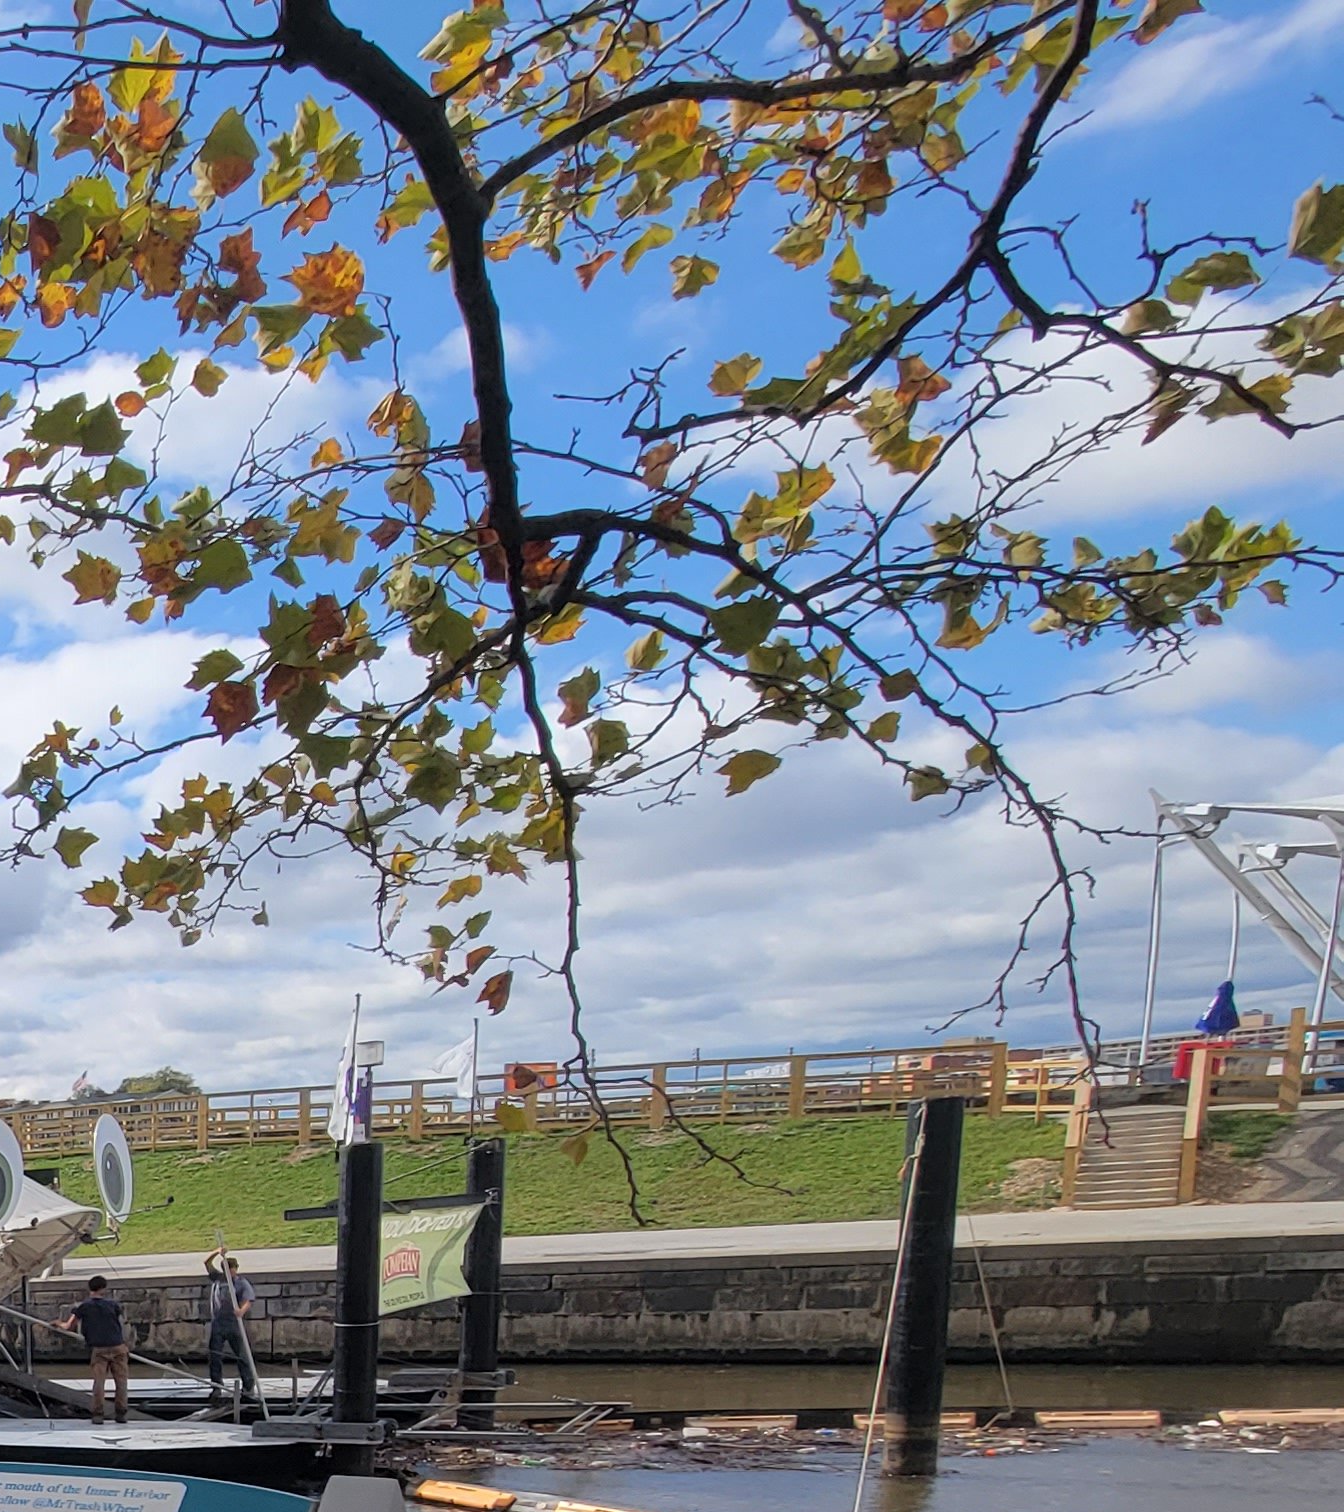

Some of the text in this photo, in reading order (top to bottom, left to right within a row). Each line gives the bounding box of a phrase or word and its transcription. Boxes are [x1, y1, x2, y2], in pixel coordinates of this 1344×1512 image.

[4, 1482, 44, 1491] mouth
[45, 1483, 61, 1492] of
[62, 1484, 82, 1494] the
[84, 1486, 121, 1496] Inner
